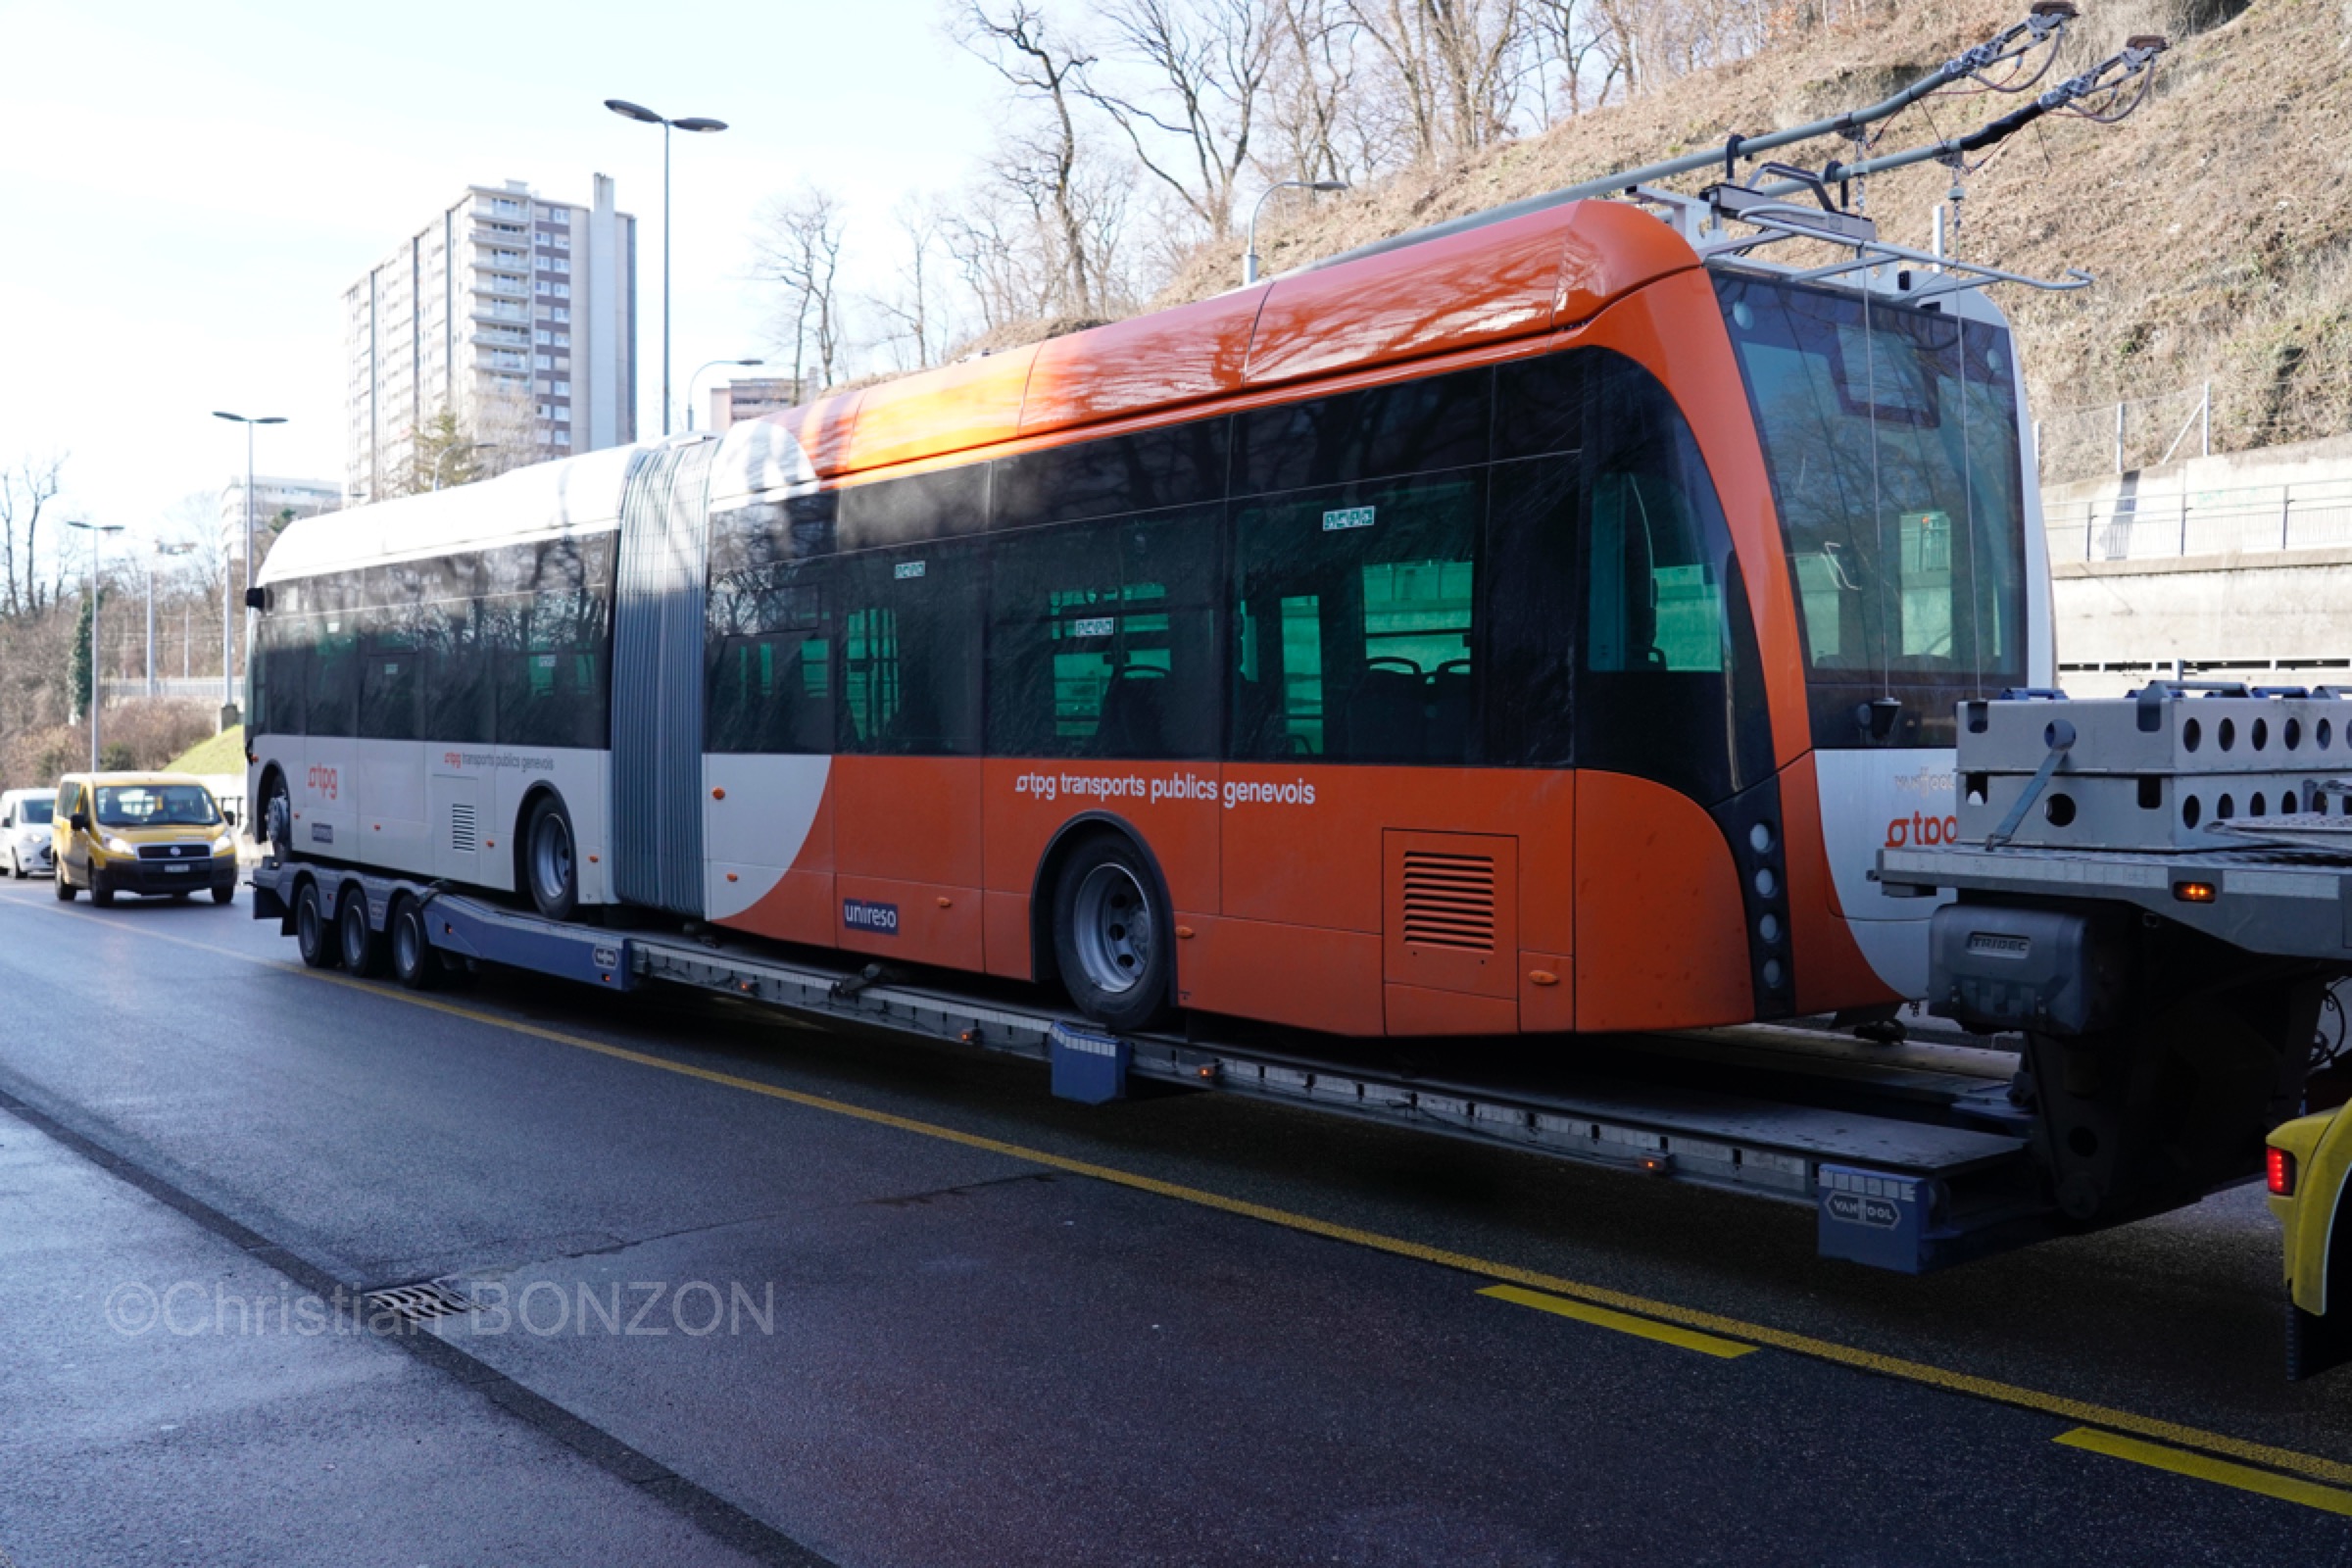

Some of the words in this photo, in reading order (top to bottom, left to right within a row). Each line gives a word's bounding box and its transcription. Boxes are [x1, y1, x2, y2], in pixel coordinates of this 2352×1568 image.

[310, 762, 338, 800] tpg
[1030, 771, 1056, 801] tpg
[1060, 771, 1146, 802] transports
[1151, 772, 1218, 804] publics
[1223, 777, 1316, 808] genevois
[845, 902, 897, 928] unireso
[1973, 937, 2029, 953] TRIDEC
